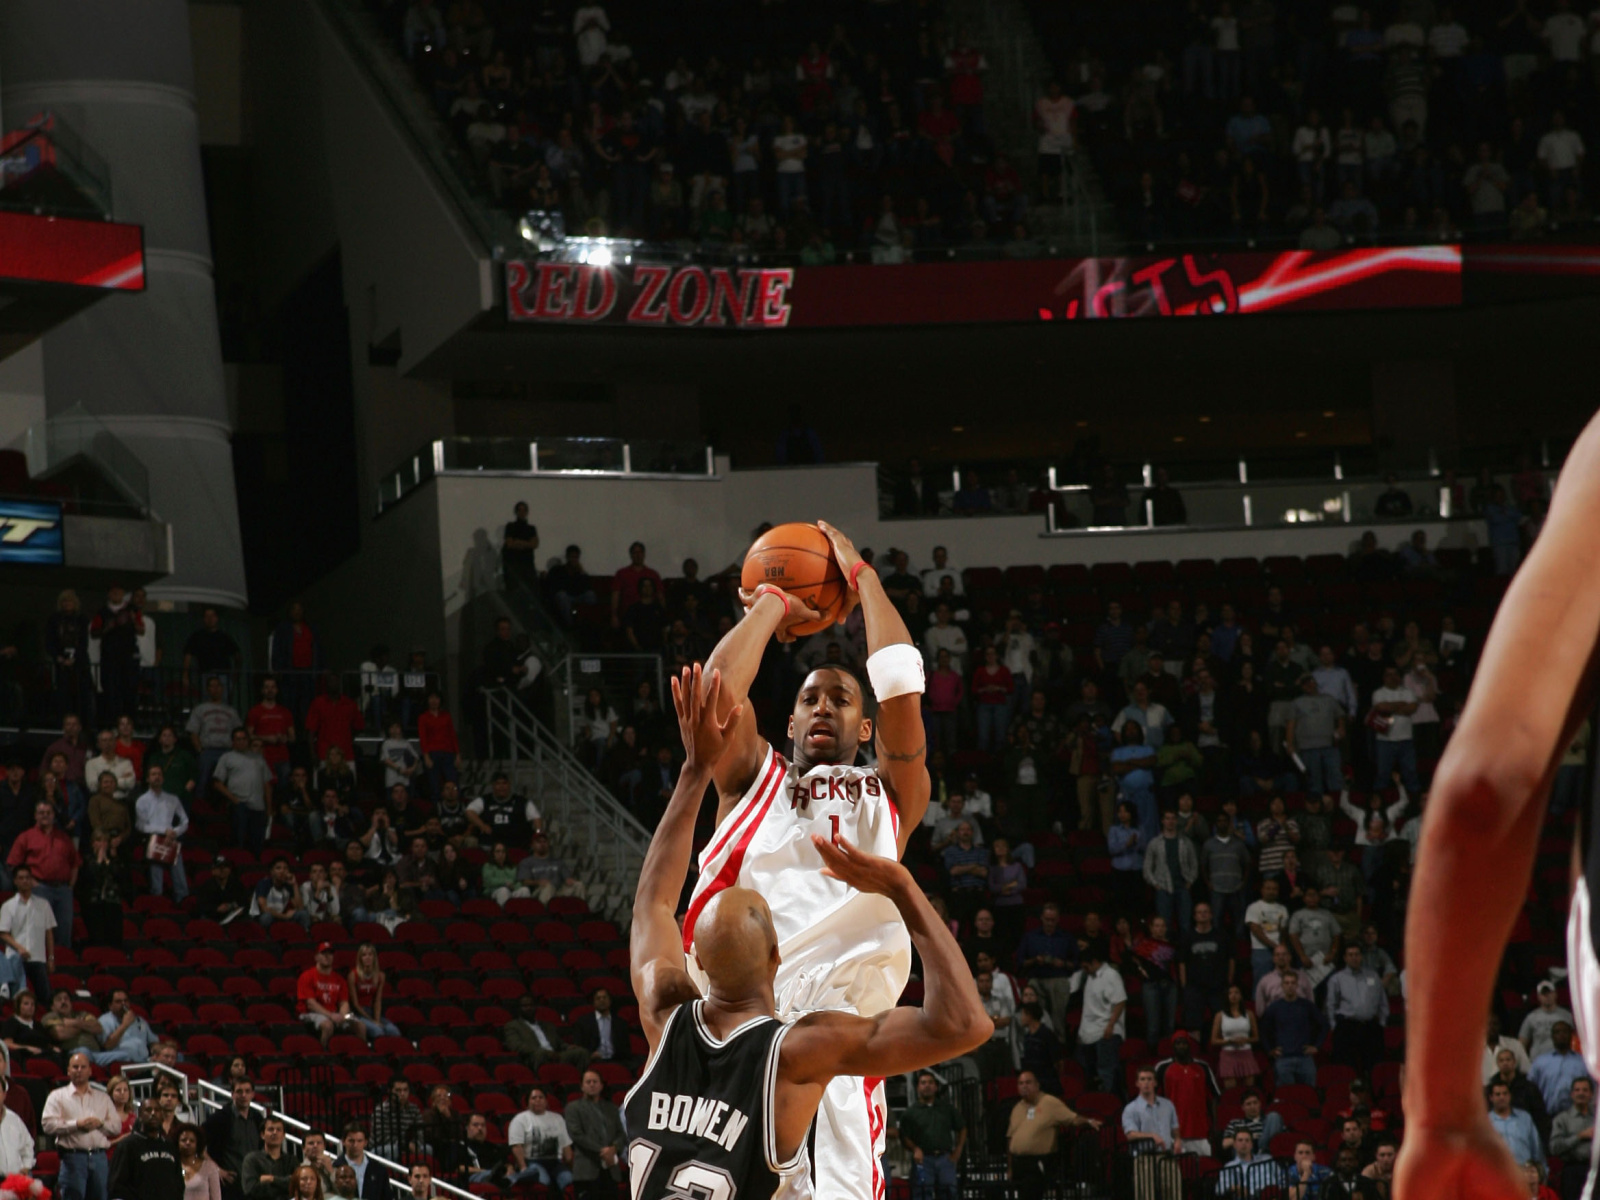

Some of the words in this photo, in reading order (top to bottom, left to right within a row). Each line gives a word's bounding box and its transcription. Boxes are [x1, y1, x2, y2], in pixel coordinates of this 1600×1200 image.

[507, 261, 617, 321] RED
[626, 264, 794, 328] ZONE
[828, 814, 840, 849] 1
[647, 1091, 749, 1153] BOWEN
